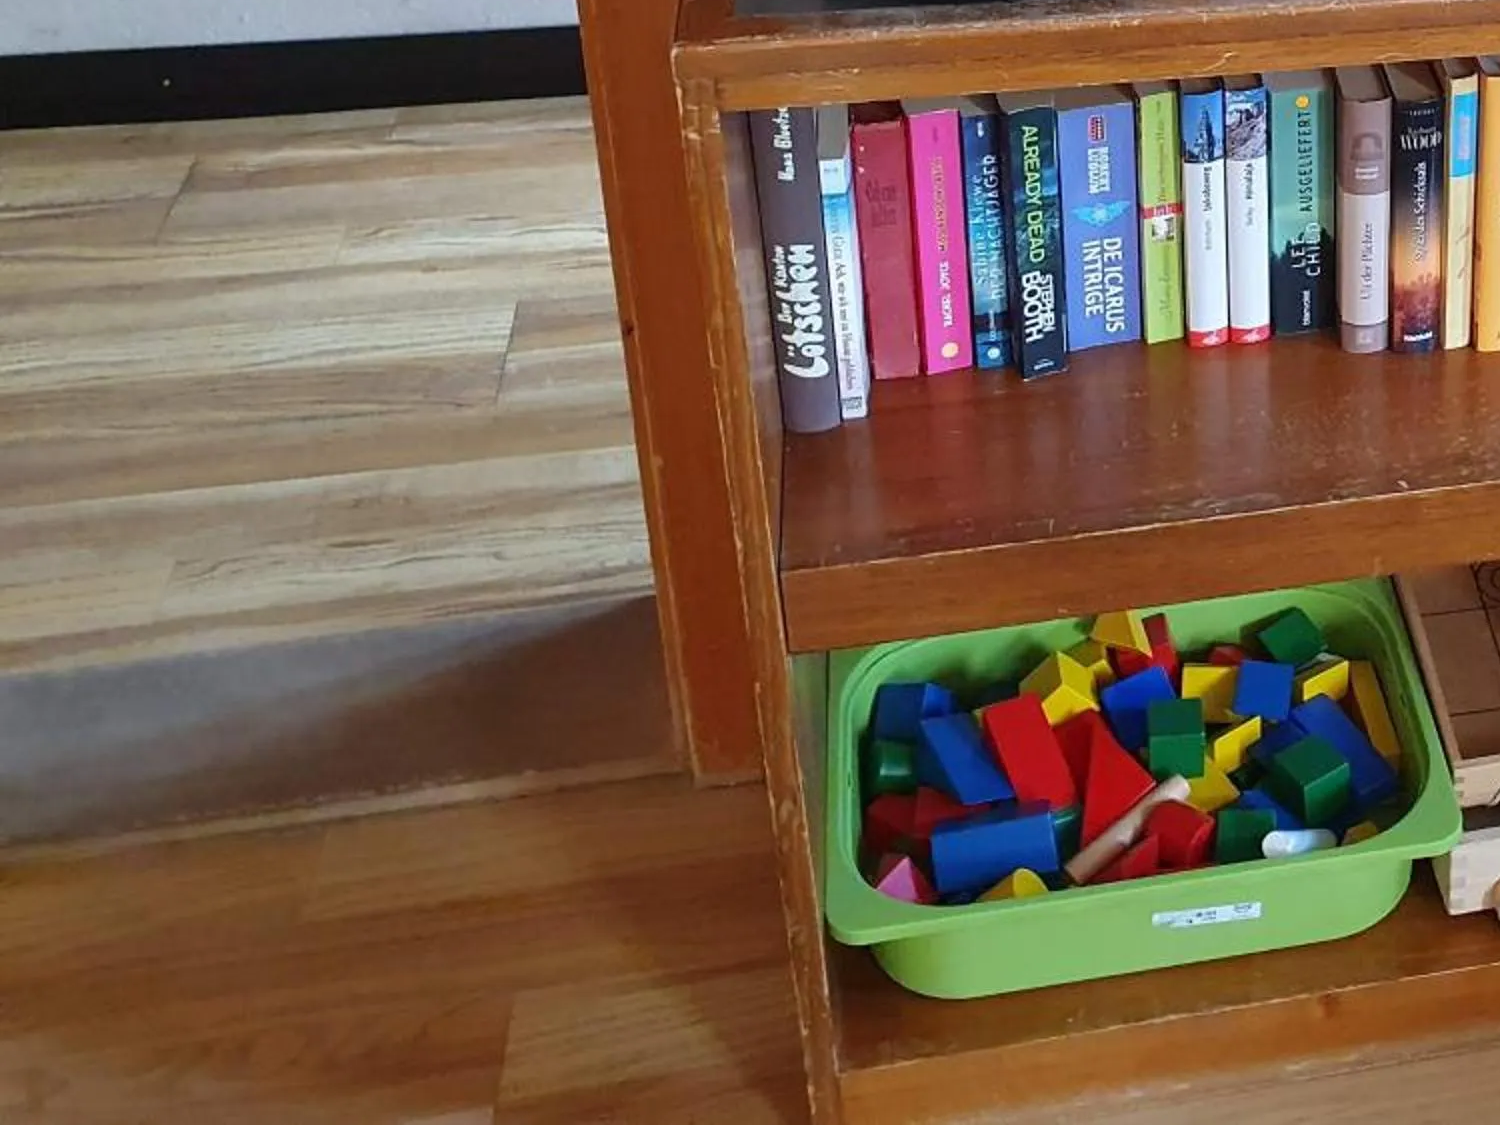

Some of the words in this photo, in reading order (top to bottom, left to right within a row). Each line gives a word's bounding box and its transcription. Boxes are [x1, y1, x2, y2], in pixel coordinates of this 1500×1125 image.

[1021, 125, 1043, 210] ALREADY
[1297, 110, 1313, 212] AUSGELIEFERT
[1027, 210, 1046, 263] DEAD
[1103, 236, 1122, 263] DE
[1291, 232, 1306, 268] LEE
[1305, 222, 1321, 277] CHILD
[777, 243, 831, 378] Lötschen
[1021, 270, 1044, 343] BOOTH
[1040, 273, 1056, 332] STEPHEN
[1082, 240, 1104, 319] INTRIGE
[1103, 266, 1126, 333] ICARUS
